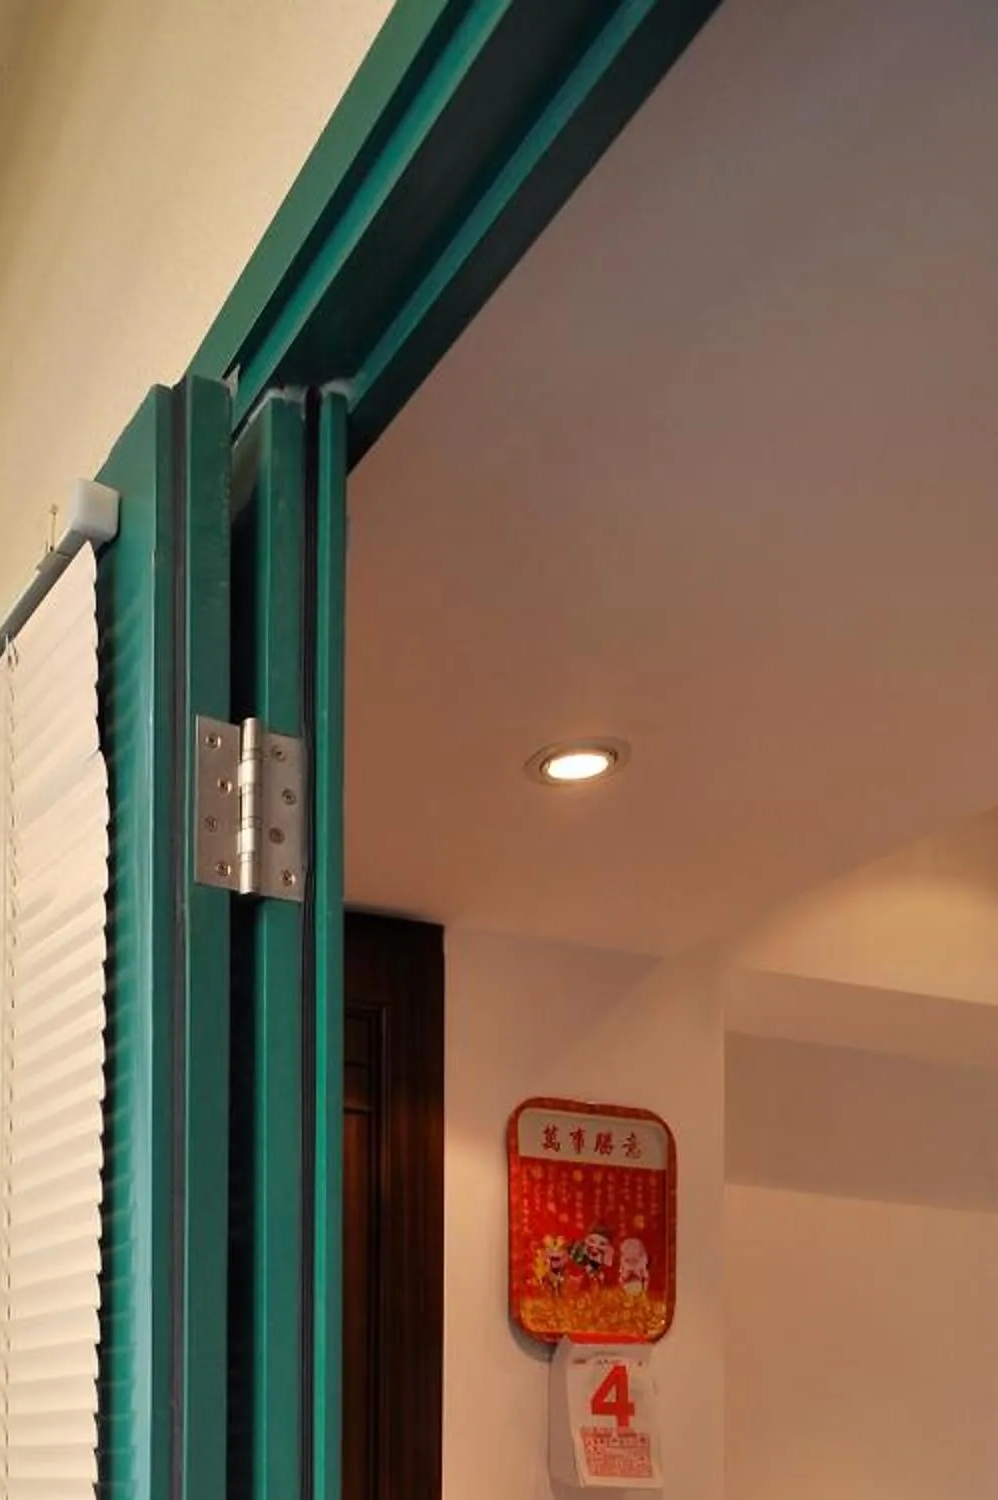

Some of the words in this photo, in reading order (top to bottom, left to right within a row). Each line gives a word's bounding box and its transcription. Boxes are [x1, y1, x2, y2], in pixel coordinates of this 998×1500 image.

[542, 1123, 642, 1159] 萬事勝意
[591, 1364, 635, 1427] 4
